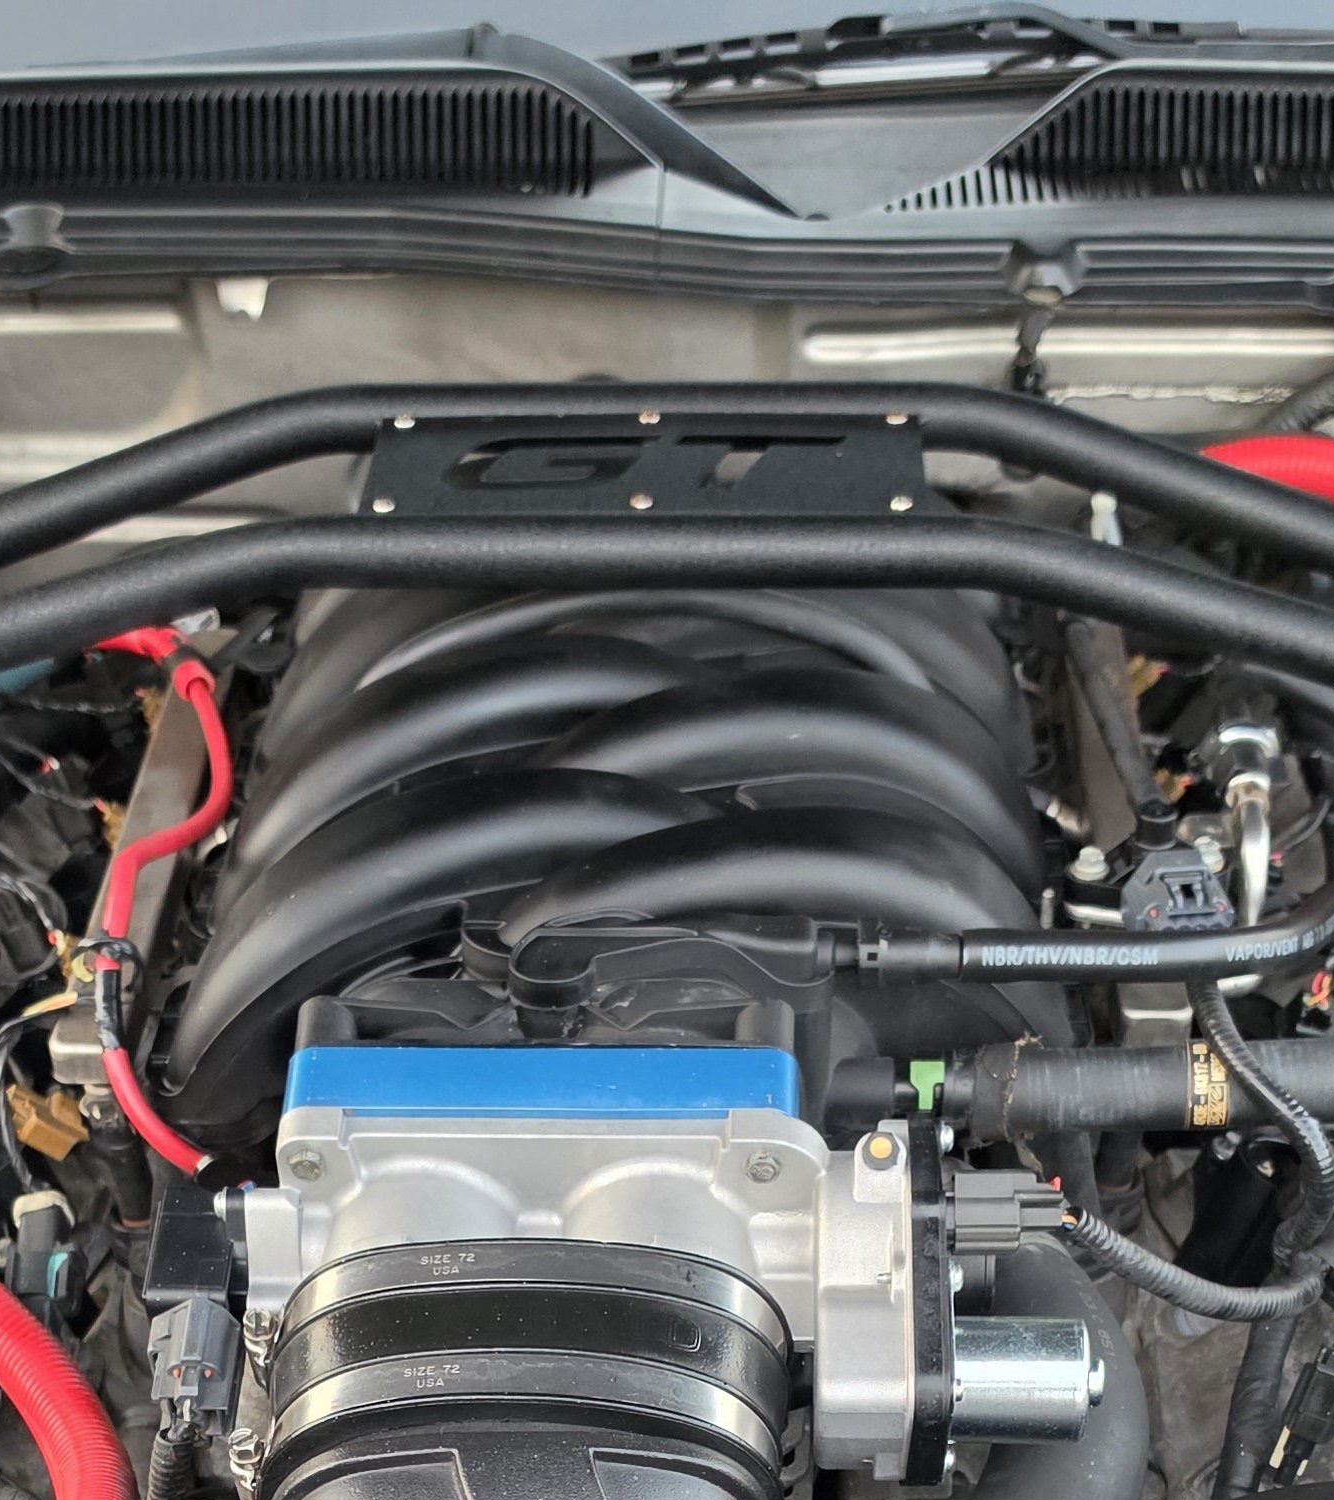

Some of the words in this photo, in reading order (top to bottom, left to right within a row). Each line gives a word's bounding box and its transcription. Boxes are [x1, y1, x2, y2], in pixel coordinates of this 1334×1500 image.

[441, 435, 848, 491] GT
[981, 945, 1159, 967] NBR/THV/NBR/CSM
[419, 1253, 452, 1266] SIZE
[458, 1252, 476, 1264] 72
[432, 1264, 460, 1277] USA
[403, 1365, 436, 1377] SIZE
[442, 1363, 461, 1375] 72
[416, 1376, 445, 1389] USA
